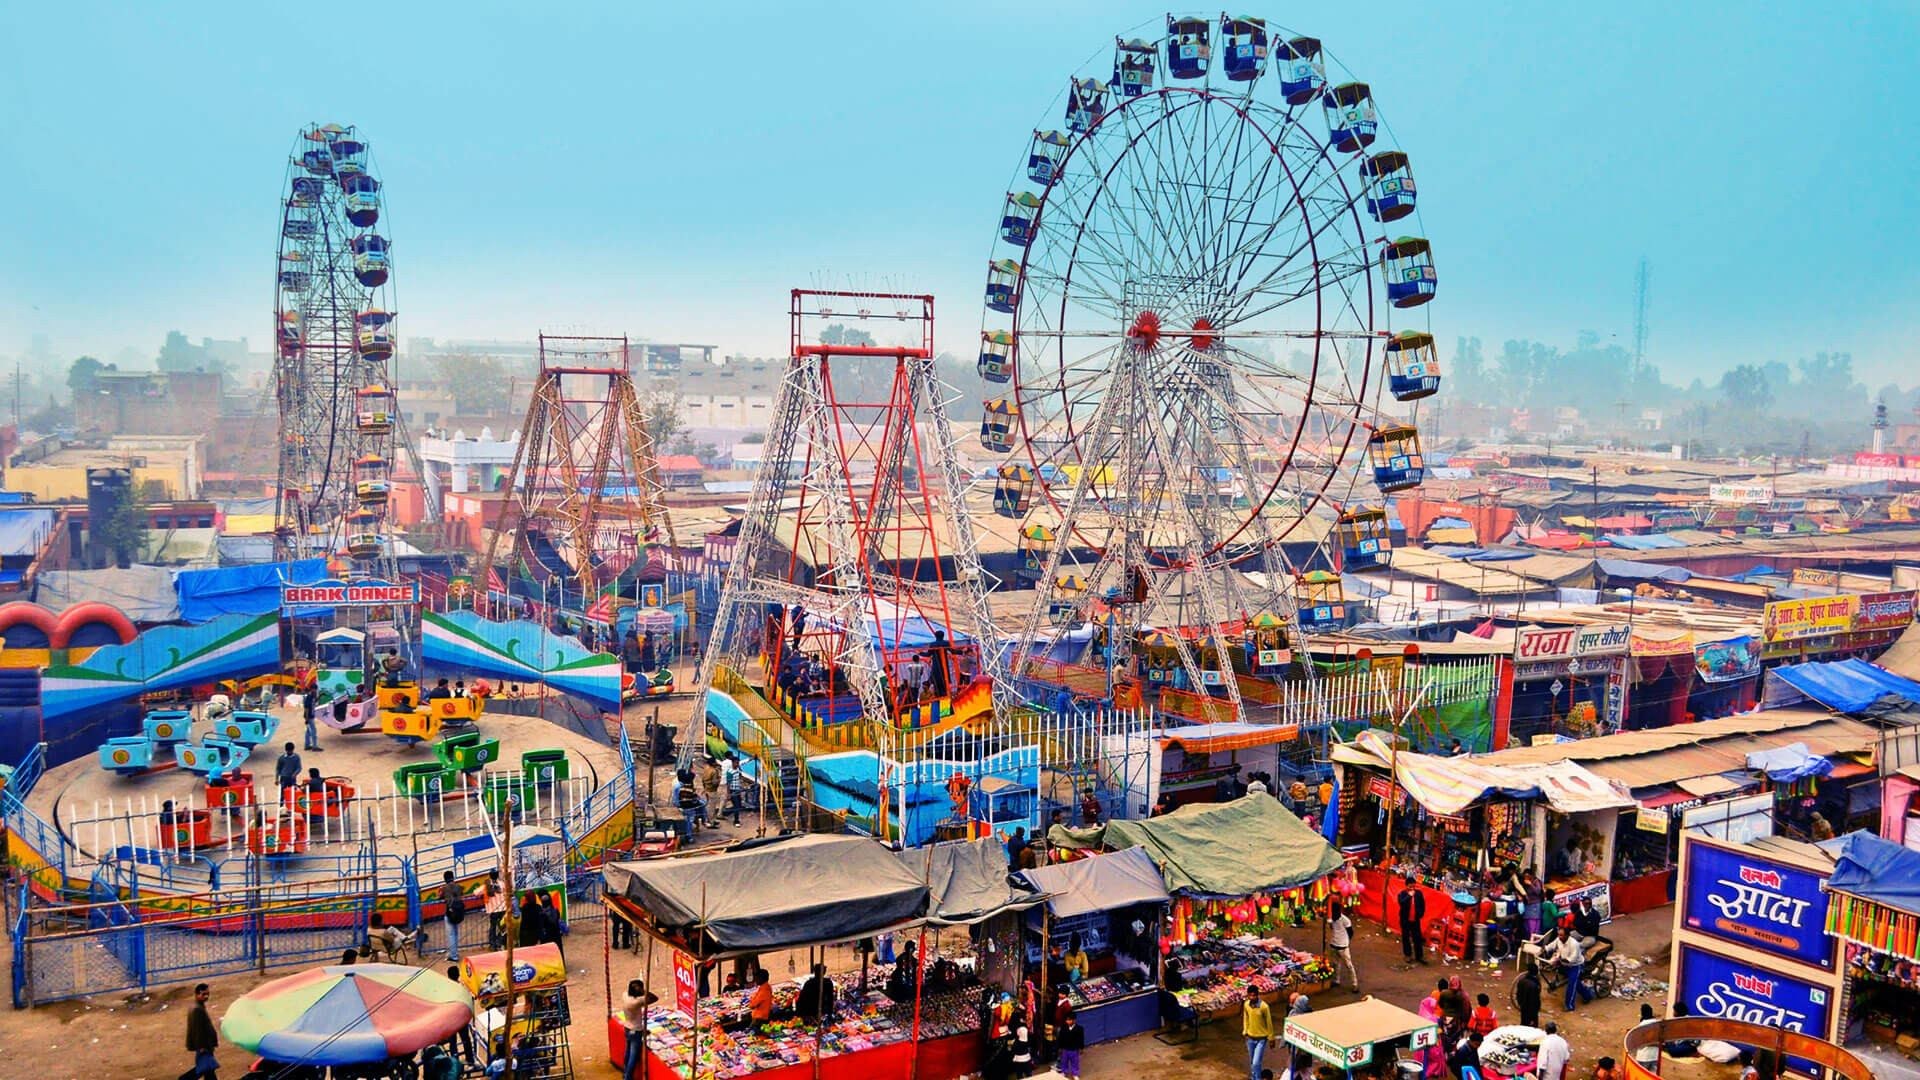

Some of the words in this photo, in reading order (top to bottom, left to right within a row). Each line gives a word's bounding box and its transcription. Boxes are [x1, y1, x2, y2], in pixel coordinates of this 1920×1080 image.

[286, 588, 345, 602] BRAK
[348, 587, 413, 601] DANCE
[1520, 630, 1576, 657] राजा
[1579, 633, 1601, 653] सुपर
[1708, 880, 1811, 927] सादा
[677, 967, 690, 987] 40
